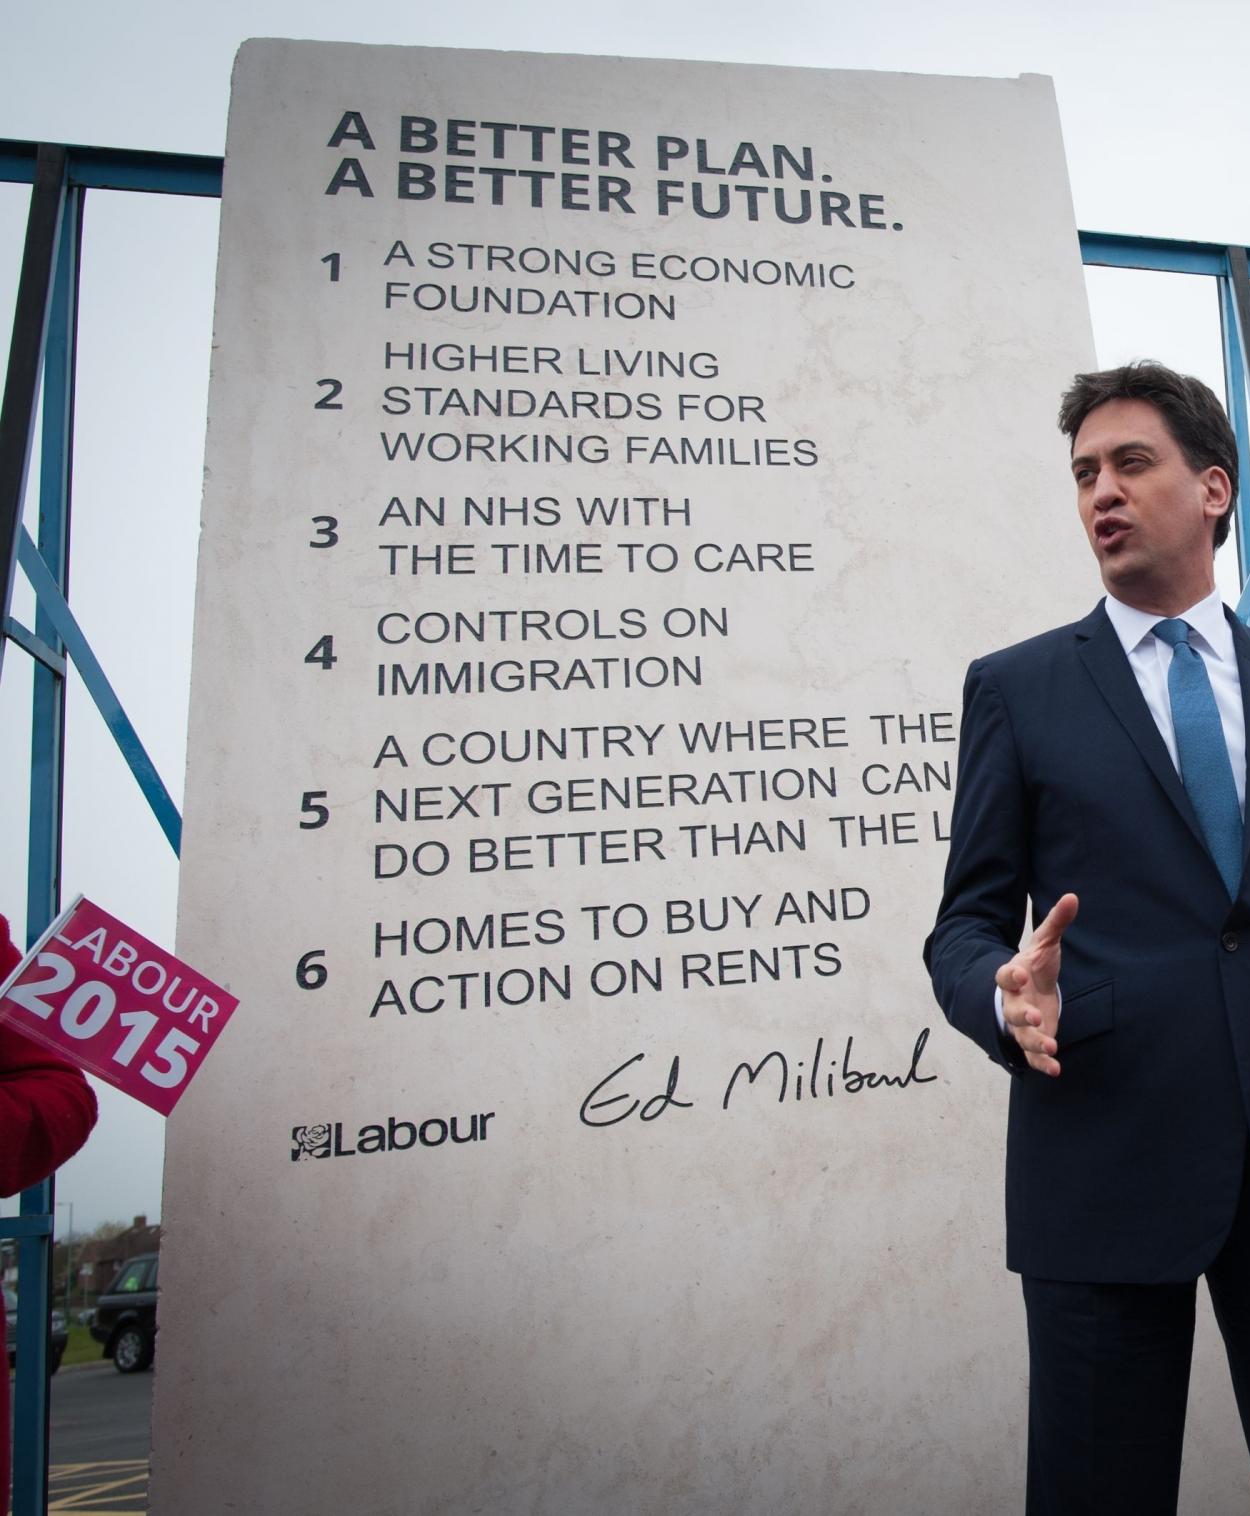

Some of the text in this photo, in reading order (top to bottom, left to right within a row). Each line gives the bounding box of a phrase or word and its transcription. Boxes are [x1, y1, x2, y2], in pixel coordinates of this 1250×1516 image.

[326, 110, 833, 184] A BETTER PLAN.
[324, 157, 904, 232] A BETTER FUTURE.
[320, 252, 341, 282] 1
[383, 239, 856, 290] A STRONG ECONOMIC
[385, 281, 676, 321] FOUNDATION
[385, 341, 719, 380] HIGHER LIVING
[314, 378, 343, 410] 2
[381, 385, 767, 423] STANDARDS FOR
[379, 431, 819, 467] WORKING FAMILIES
[309, 515, 339, 549] 3
[378, 496, 691, 528] AN NHS WITH
[378, 543, 815, 576] THE TIME TO CARE
[377, 607, 730, 645] CONTROLS ON
[304, 634, 338, 671] 4
[377, 655, 703, 697] IMMIGRATION
[372, 712, 956, 769] A COUNTRY WHERE THE
[299, 790, 330, 830] 5
[375, 761, 951, 823] NEXT GENERATION CAN
[374, 843, 450, 880] DO
[469, 827, 668, 874] BETTER
[678, 818, 806, 859] THAN
[828, 810, 919, 849] THE
[374, 886, 871, 959] HOMES TO BUY AND
[295, 949, 328, 991] 6
[368, 942, 843, 1019] ACTION ON RENTS
[4, 952, 201, 1089] 2015
[579, 1052, 694, 1128] Ed
[334, 1111, 496, 1158] Labour
